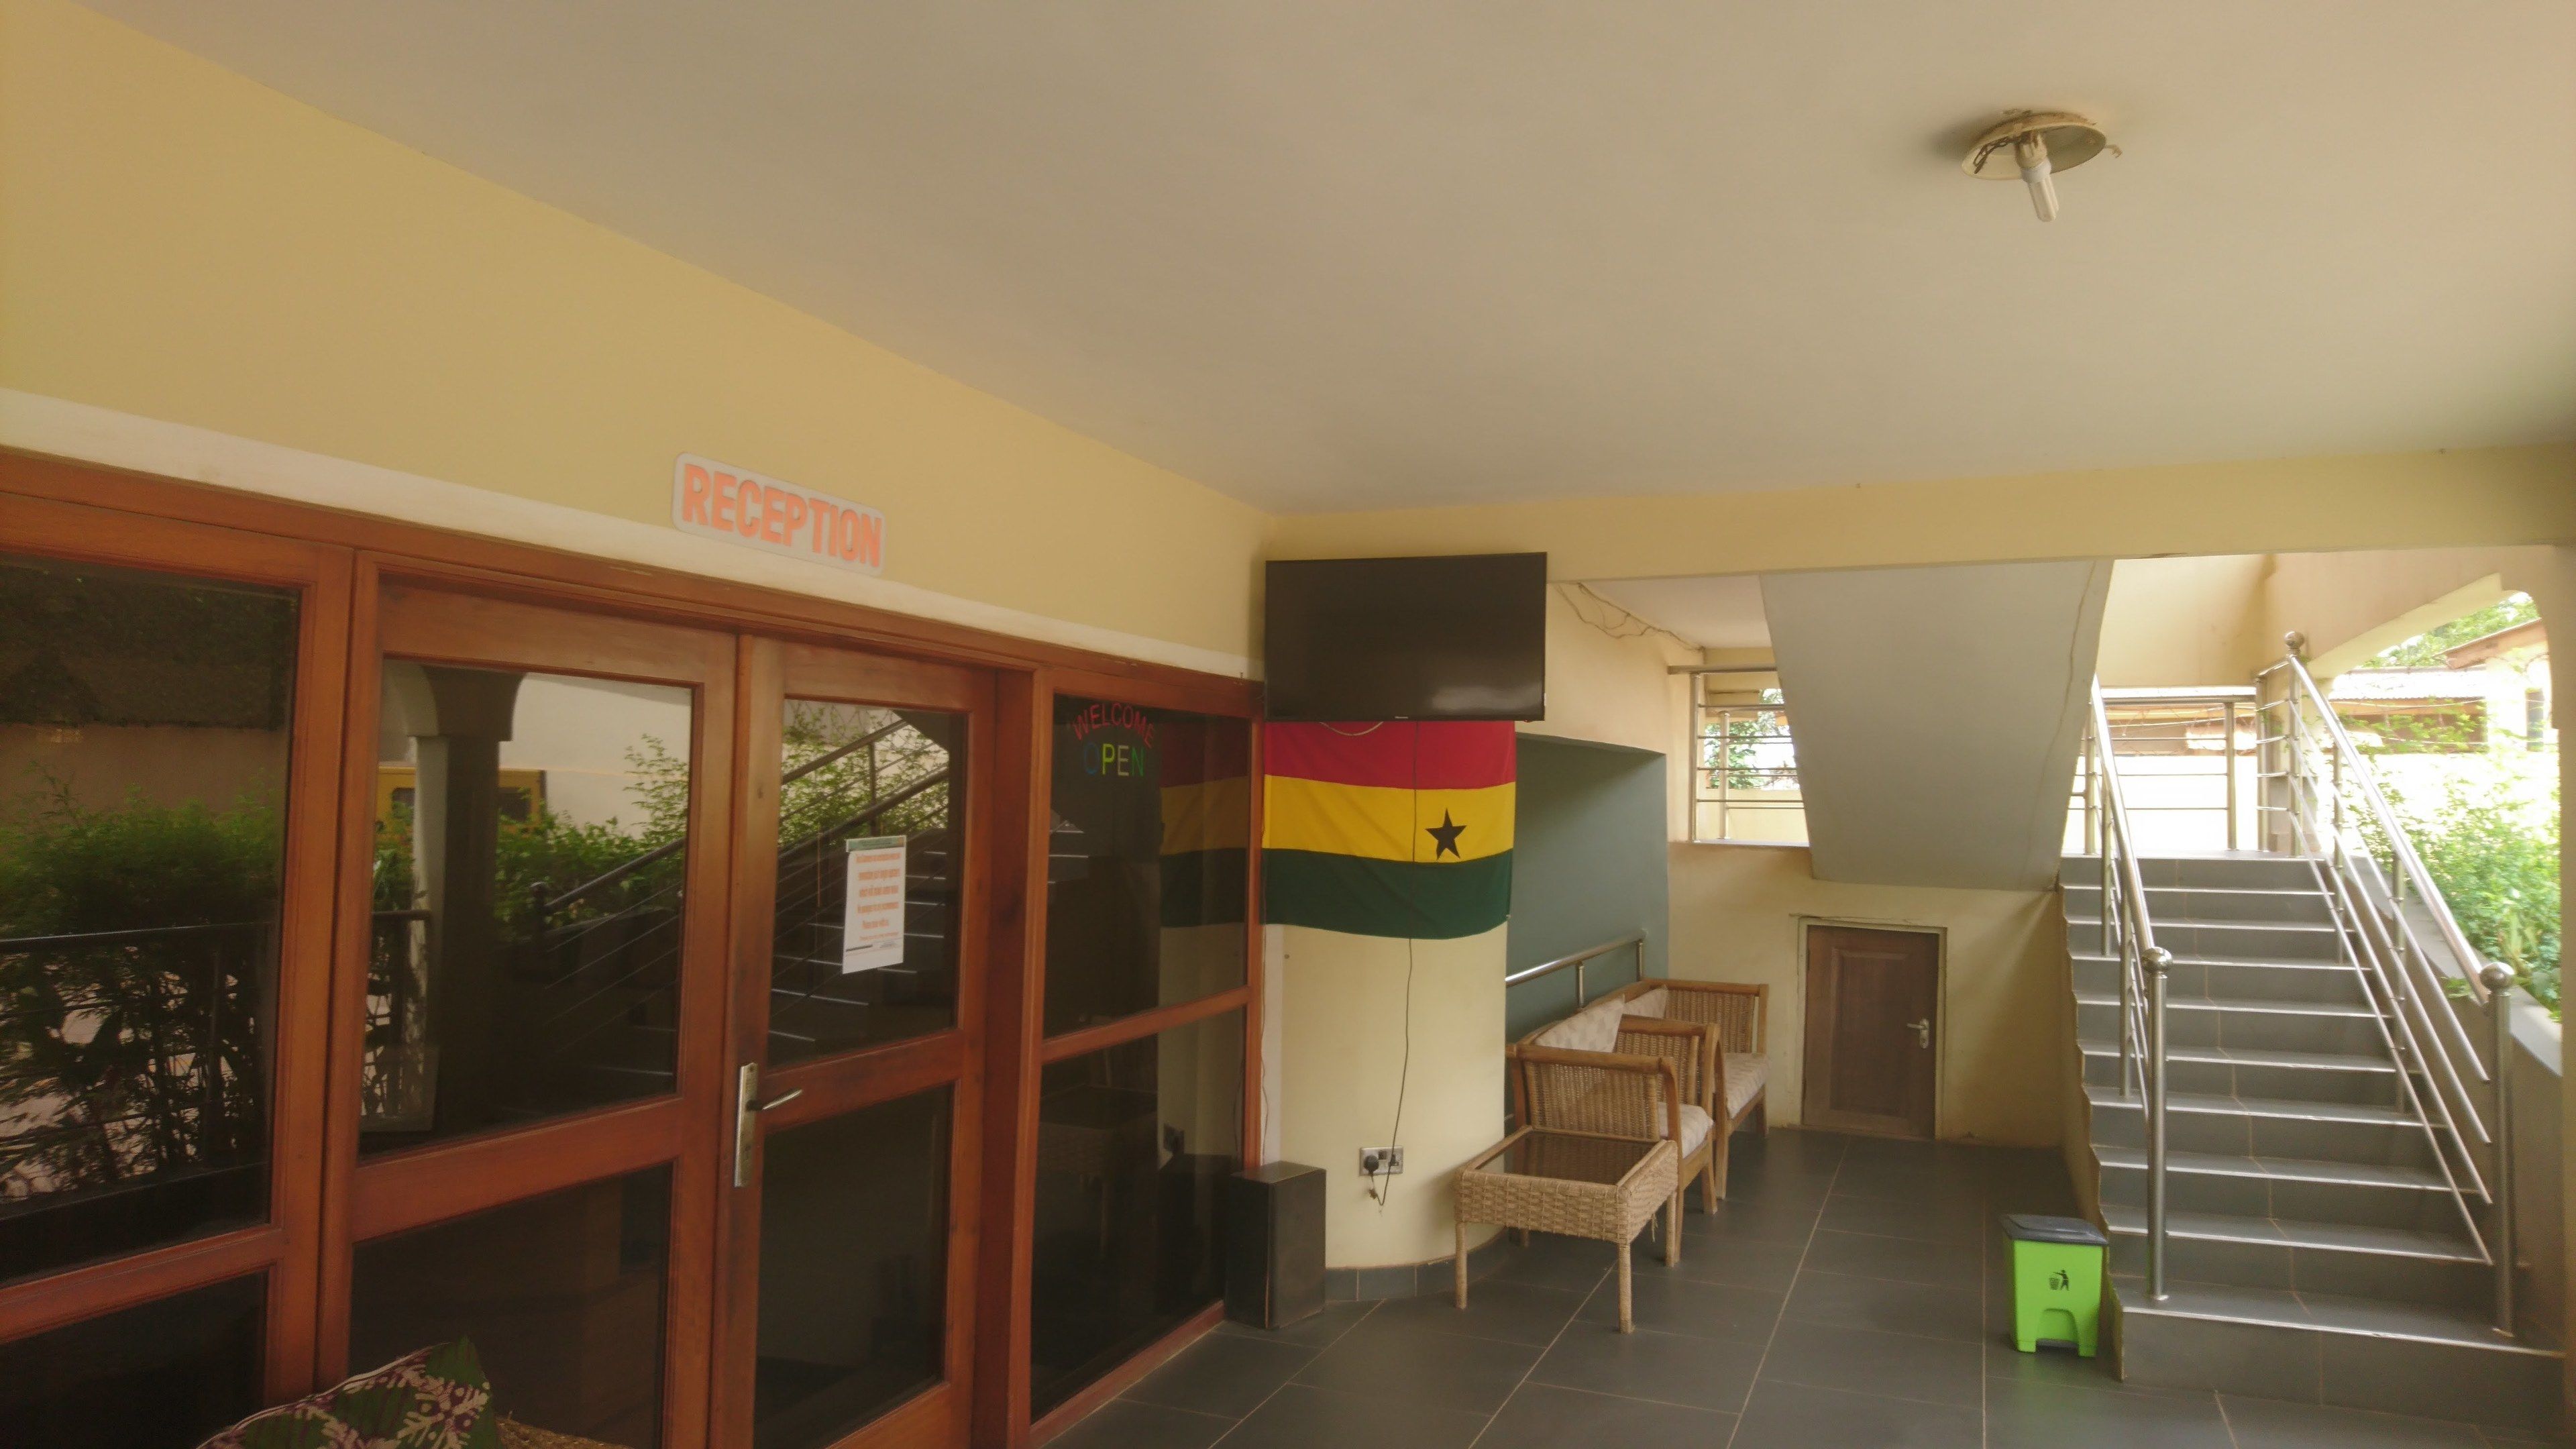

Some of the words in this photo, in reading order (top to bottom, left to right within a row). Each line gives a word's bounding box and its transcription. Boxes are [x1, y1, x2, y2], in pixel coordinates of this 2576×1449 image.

[682, 464, 882, 568] RECEPTION
[1073, 702, 1154, 749] WELCOME
[1084, 742, 1144, 776] OPEN
